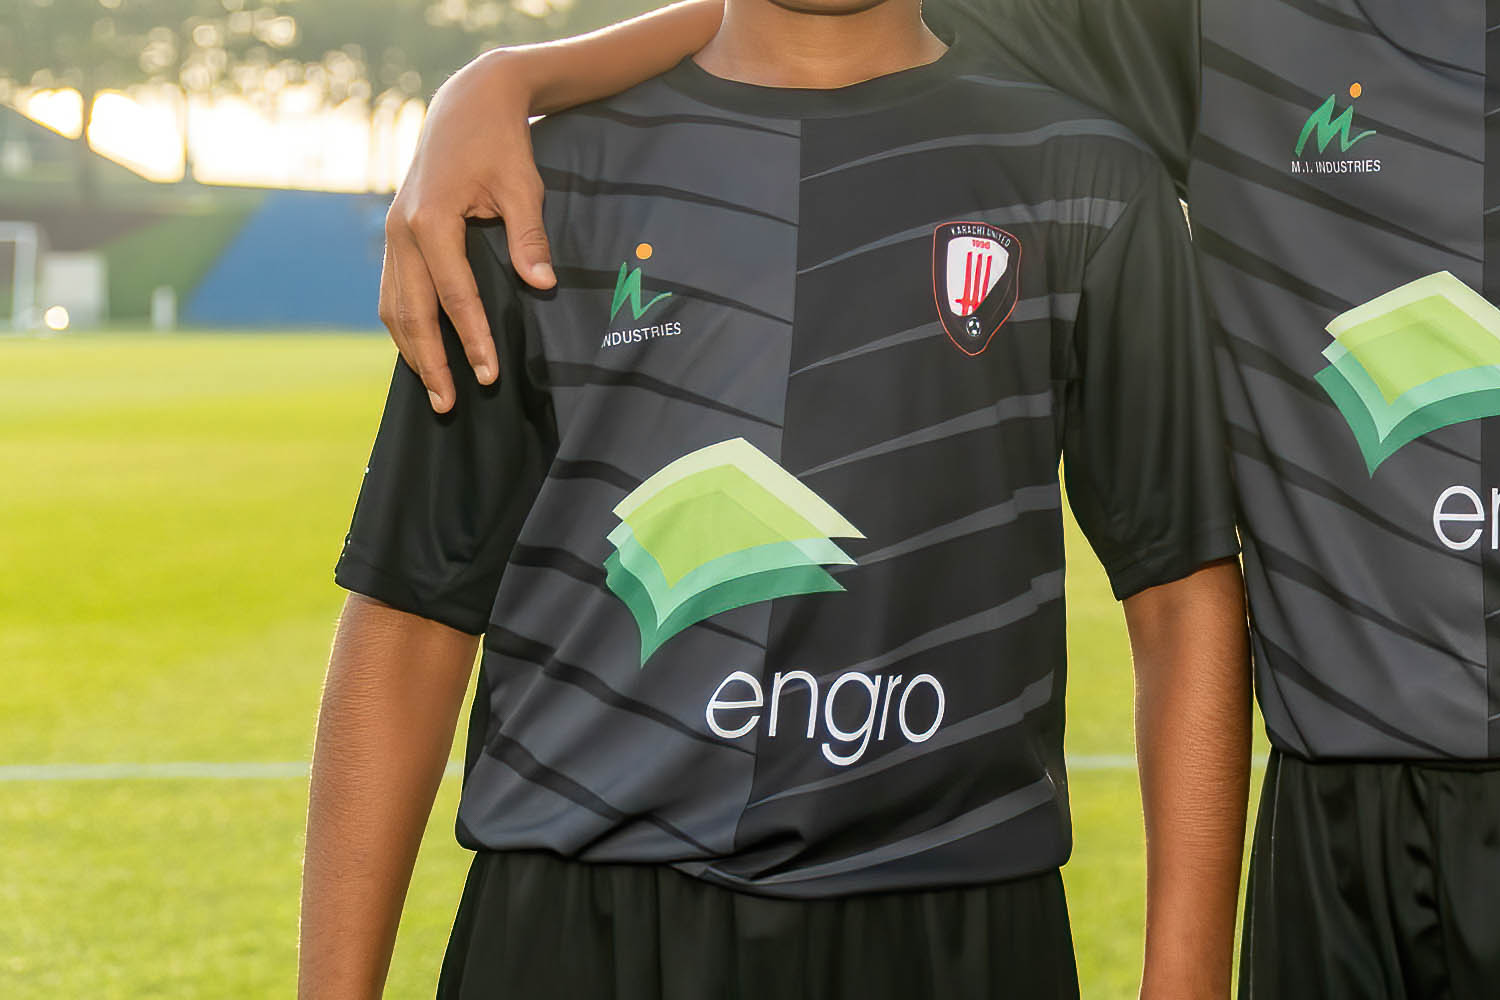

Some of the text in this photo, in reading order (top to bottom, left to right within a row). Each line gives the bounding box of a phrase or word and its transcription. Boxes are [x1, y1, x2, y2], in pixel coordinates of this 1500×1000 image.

[1291, 160, 1381, 174] M.I. INDUSTRIES
[706, 671, 945, 765] engro
